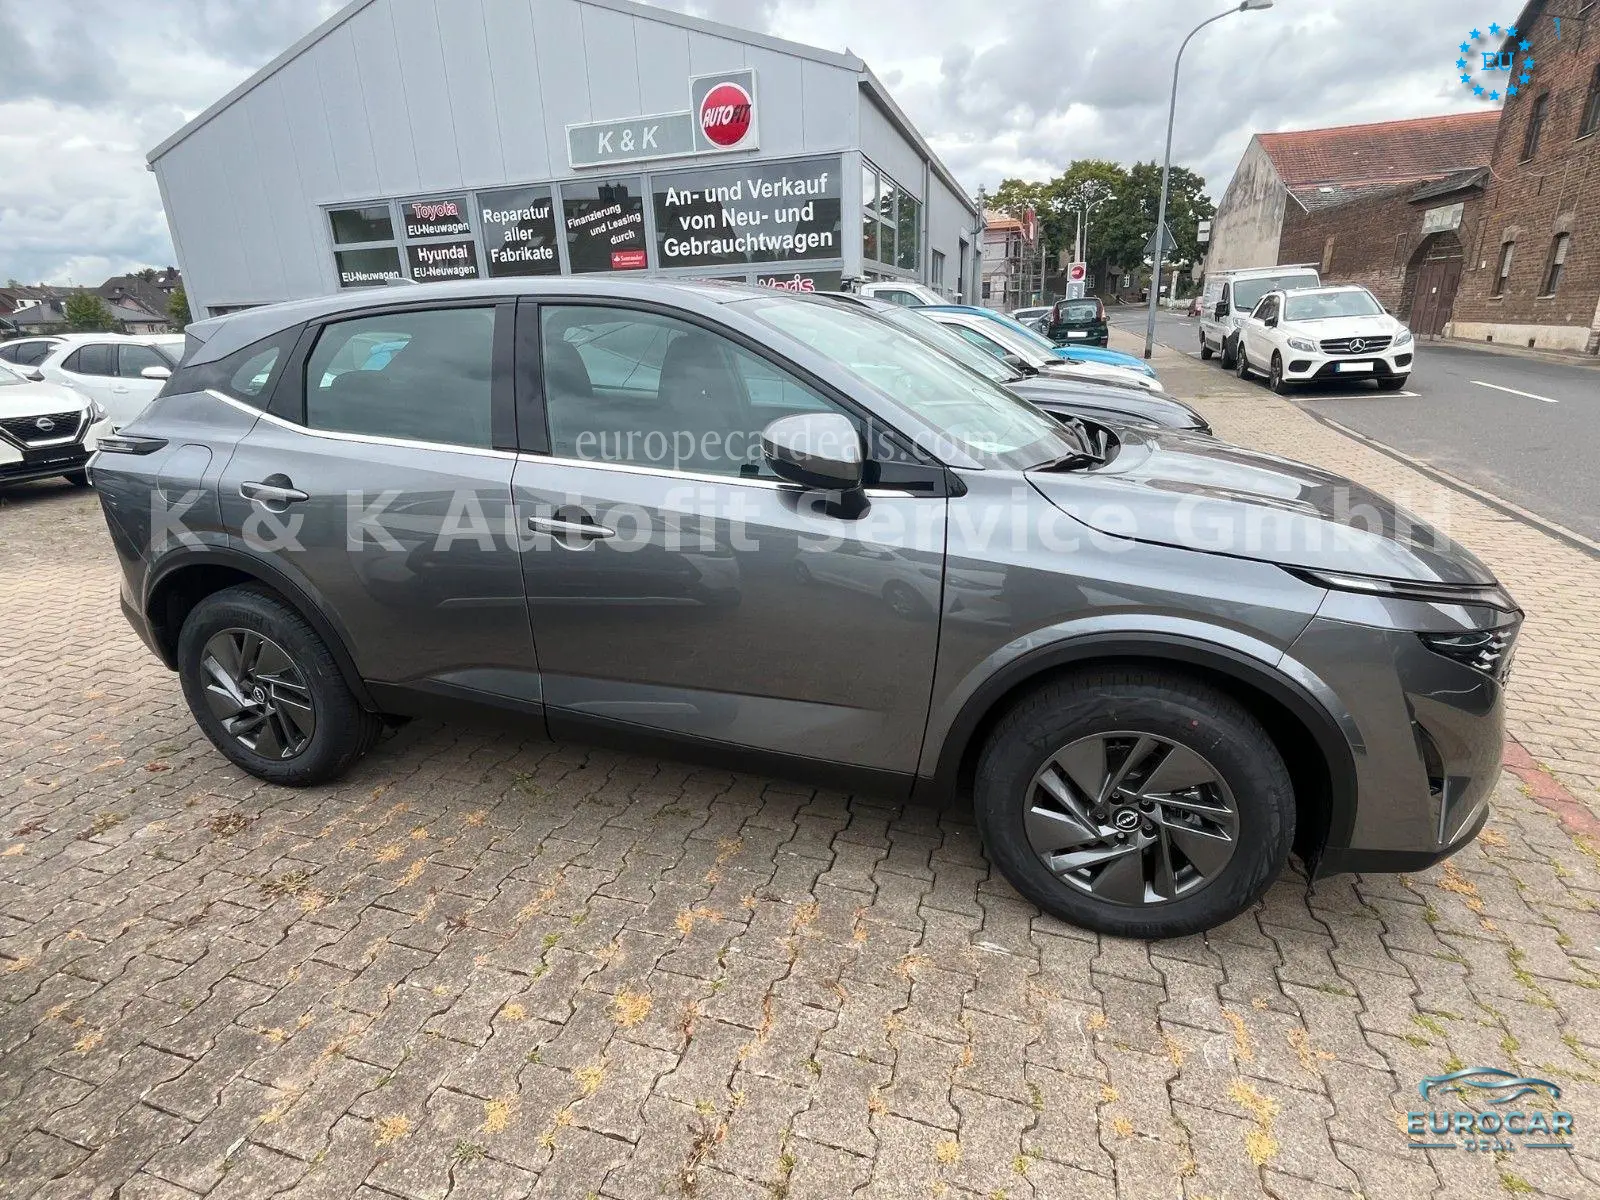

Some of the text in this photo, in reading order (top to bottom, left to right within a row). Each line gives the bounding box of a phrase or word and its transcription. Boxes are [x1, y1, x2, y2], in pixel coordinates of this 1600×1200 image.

[703, 104, 751, 128] AUTOFIT
[598, 126, 659, 154] K & K
[665, 173, 829, 207] An- und Verkauf
[412, 202, 458, 220] Toyota
[482, 205, 550, 226] Reparatur
[567, 204, 621, 228] Finanzierung
[679, 201, 814, 231] von Neu- und
[407, 222, 470, 236] EU-Neuwagen
[504, 227, 533, 242] aller
[590, 212, 642, 237] und Leasing
[610, 230, 635, 245] durch
[664, 231, 833, 257] Gebrauchtwagen
[417, 244, 468, 263] Hyundai
[490, 246, 554, 263] Fabrikate
[341, 270, 400, 283] EU-Neuwagen
[413, 264, 476, 278] EU-Neuwagen
